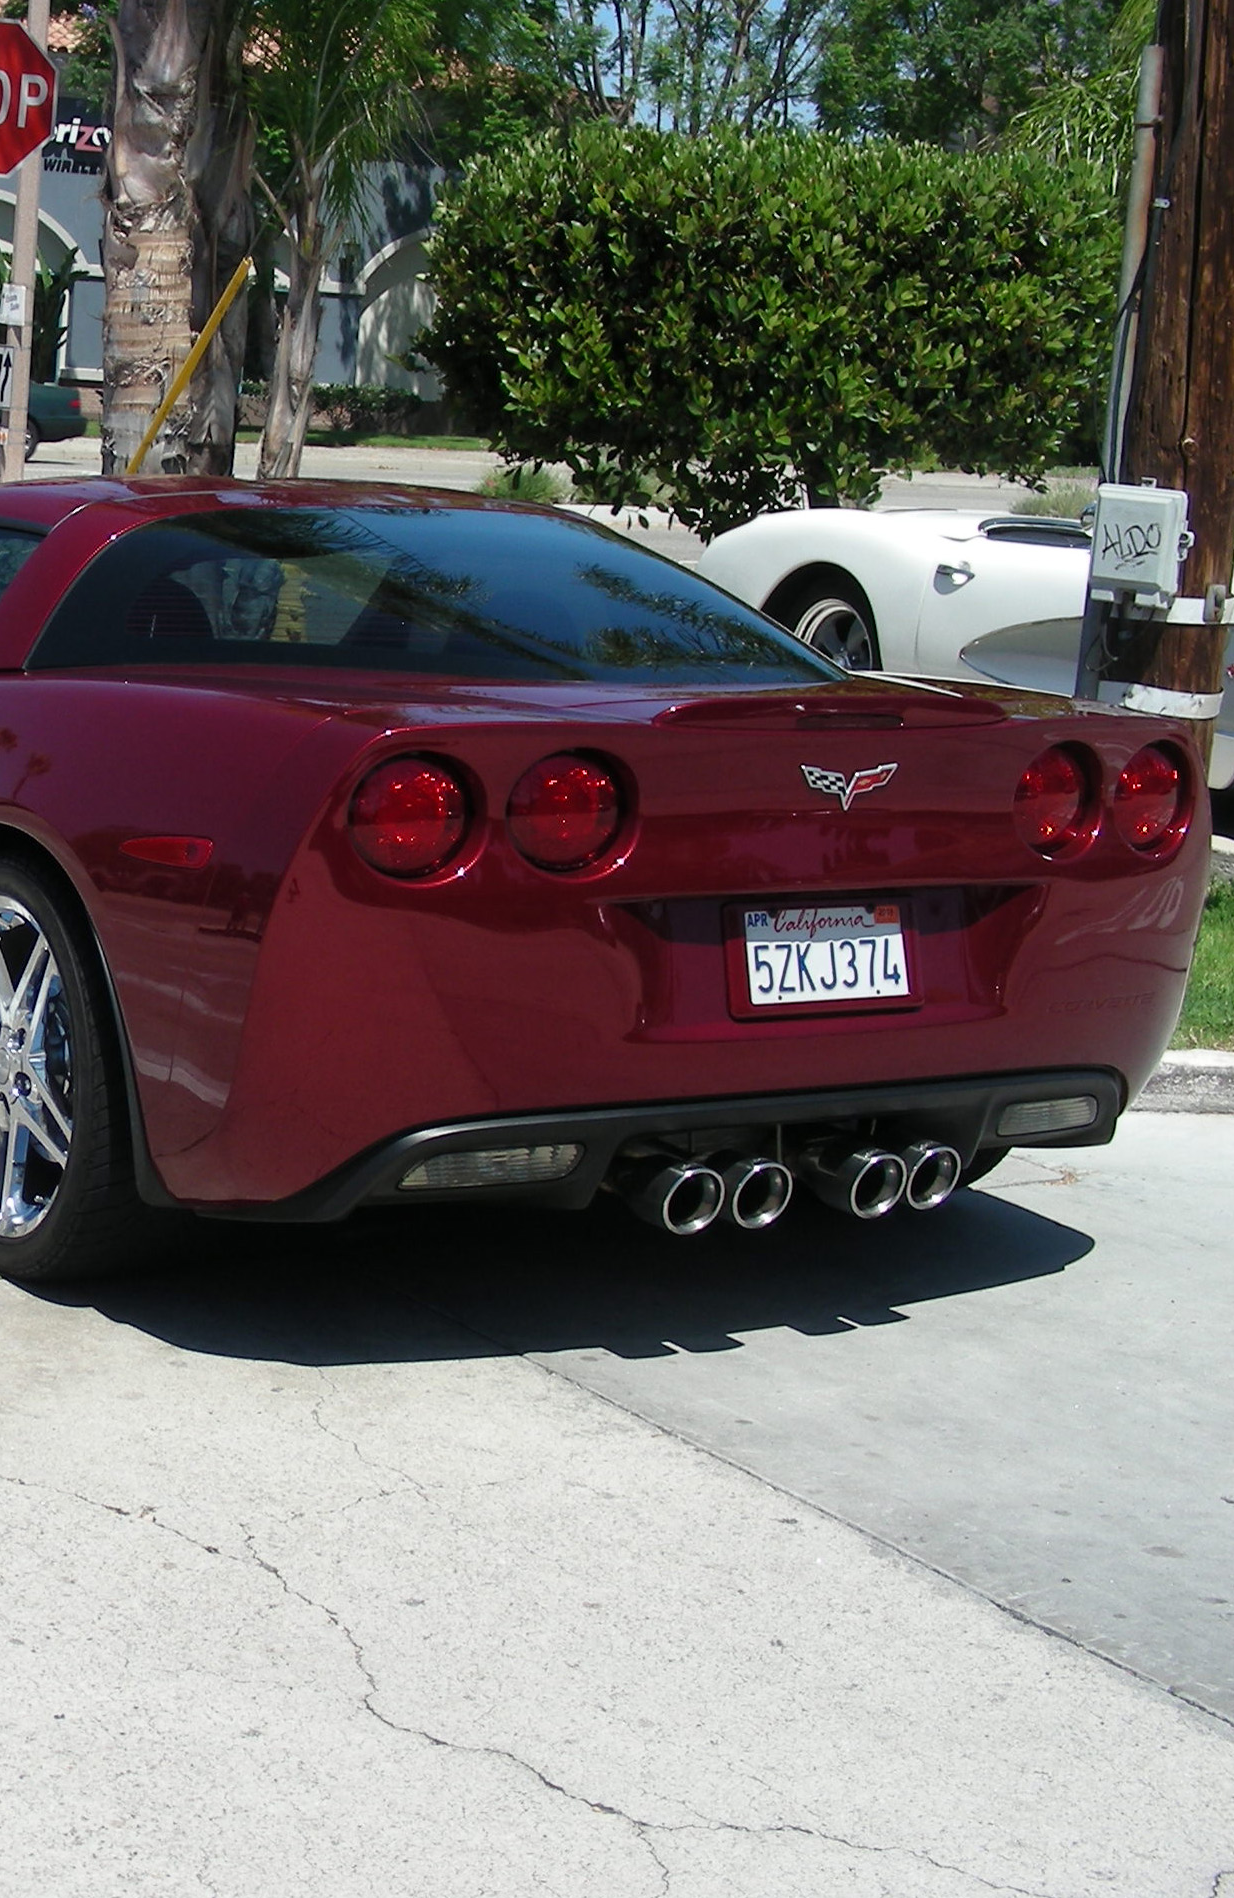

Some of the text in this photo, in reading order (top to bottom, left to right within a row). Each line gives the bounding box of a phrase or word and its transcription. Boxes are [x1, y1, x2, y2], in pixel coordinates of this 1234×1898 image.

[1102, 523, 1161, 560] ALDO
[747, 912, 769, 928] APR
[773, 909, 875, 938] California
[754, 938, 901, 994] 5ZKJ374
